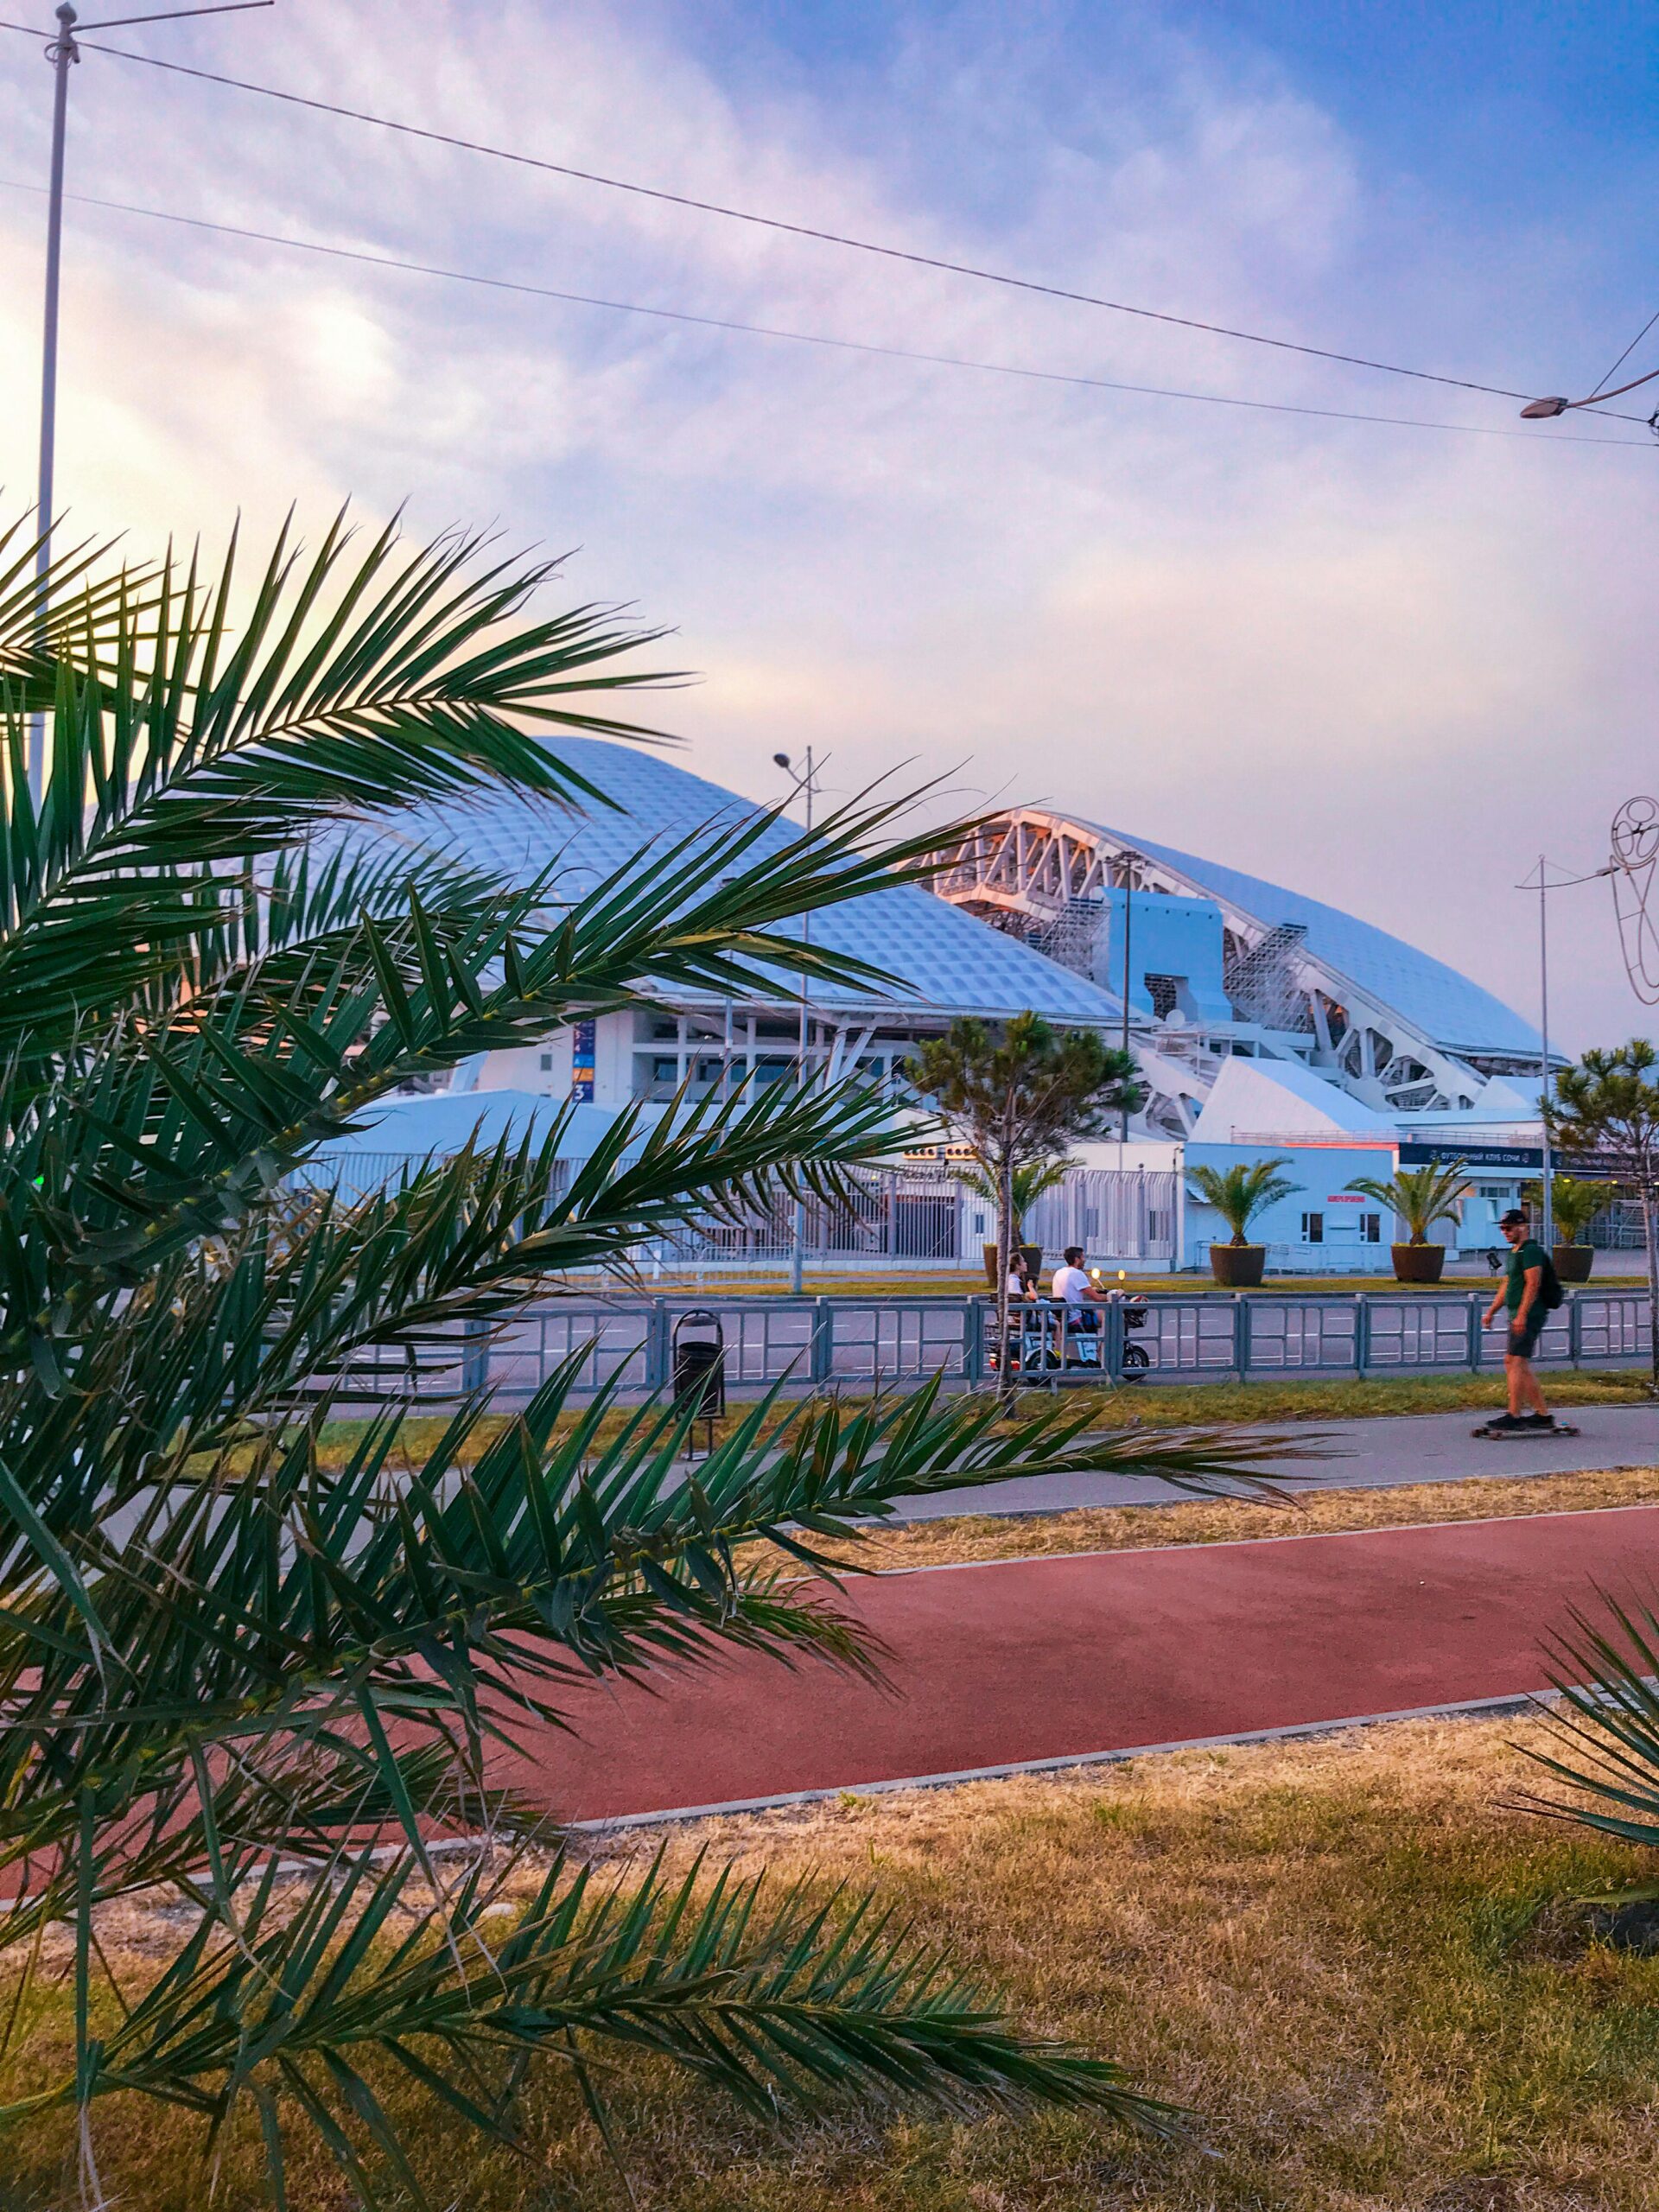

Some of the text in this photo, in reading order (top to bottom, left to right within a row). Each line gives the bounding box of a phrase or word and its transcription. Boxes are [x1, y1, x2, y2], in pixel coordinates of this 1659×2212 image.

[574, 1084, 585, 1100] 3
[1484, 1153, 1501, 1161] КЛУБ
[1502, 1154, 1521, 1162] СОЧИ
